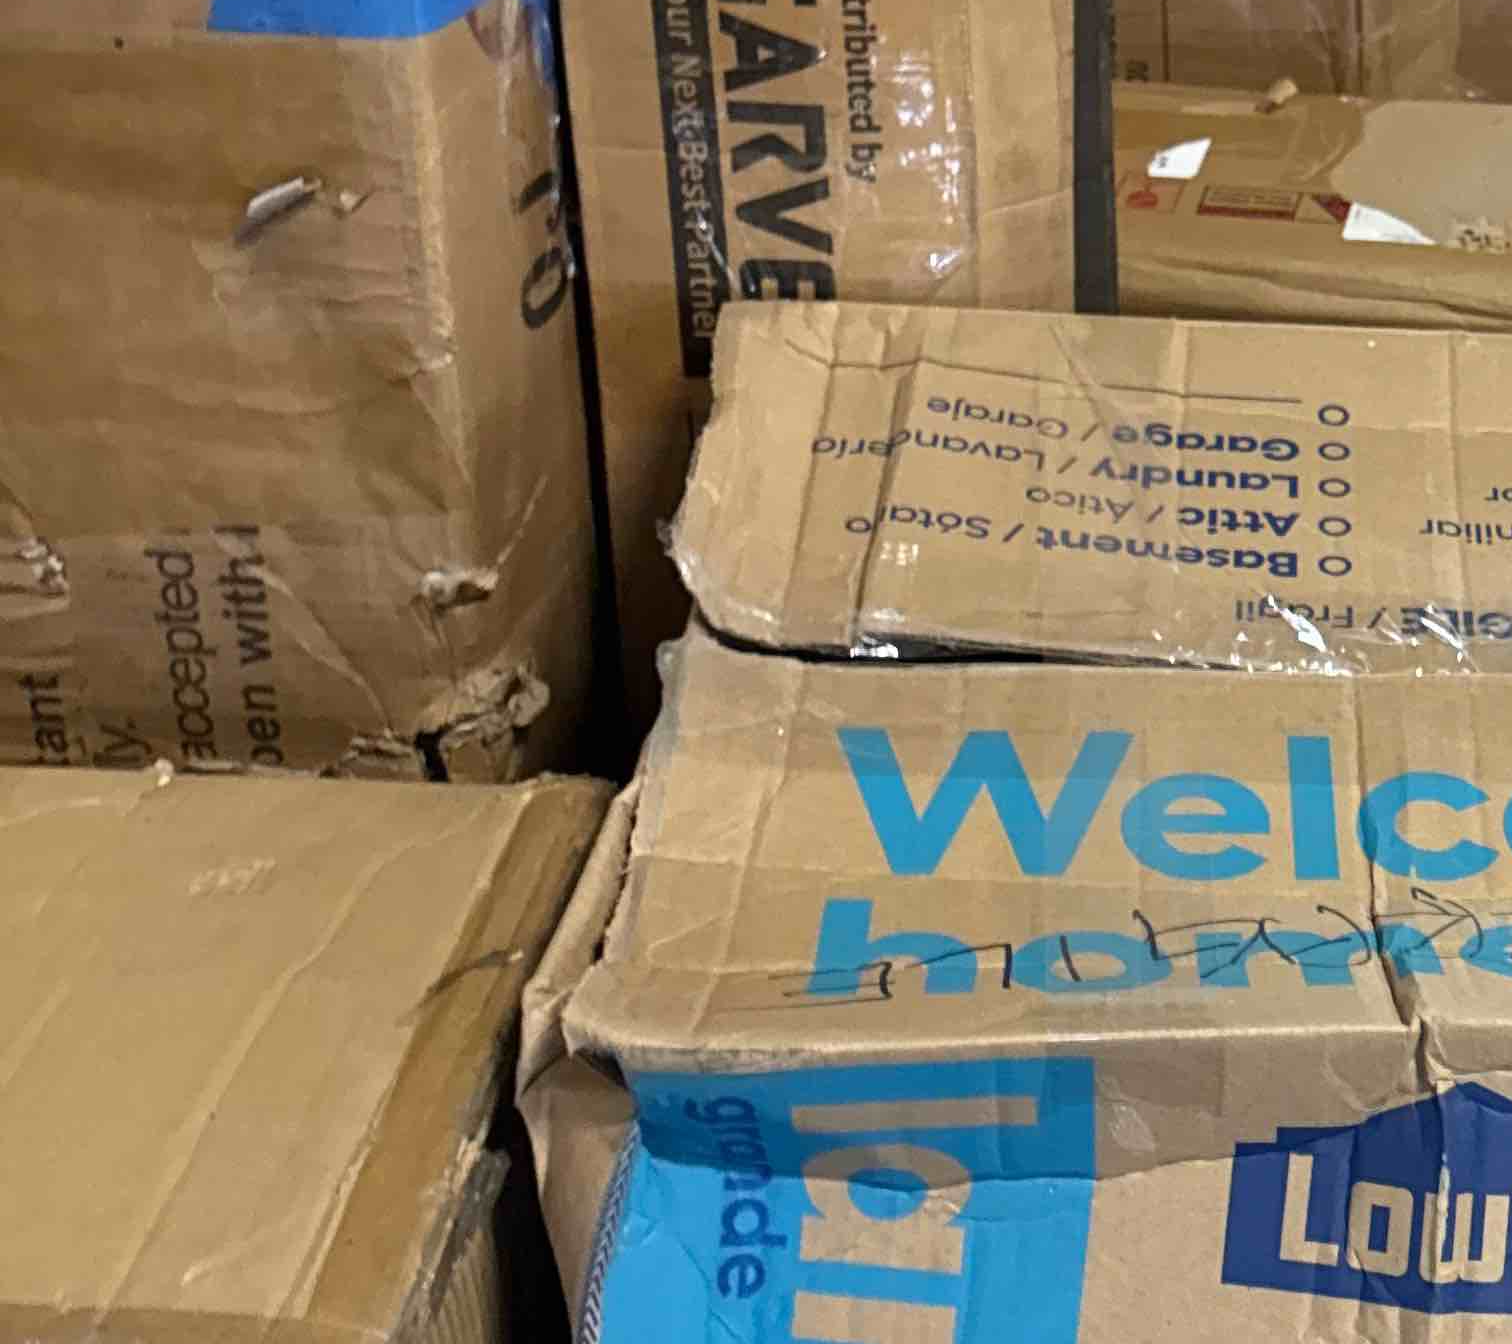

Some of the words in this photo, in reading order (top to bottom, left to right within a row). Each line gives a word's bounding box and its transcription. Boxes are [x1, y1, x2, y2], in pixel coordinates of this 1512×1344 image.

[667, 56, 705, 129] Next
[847, 142, 883, 184] by
[927, 394, 1069, 438] Garaje
[1113, 423, 1299, 460] Garage
[1098, 458, 1298, 498] Laundry
[1177, 507, 1299, 536] Attic
[1038, 526, 1298, 577] Basement
[217, 554, 272, 665] with
[144, 548, 218, 760] accepted
[684, 1096, 790, 1300] grande
